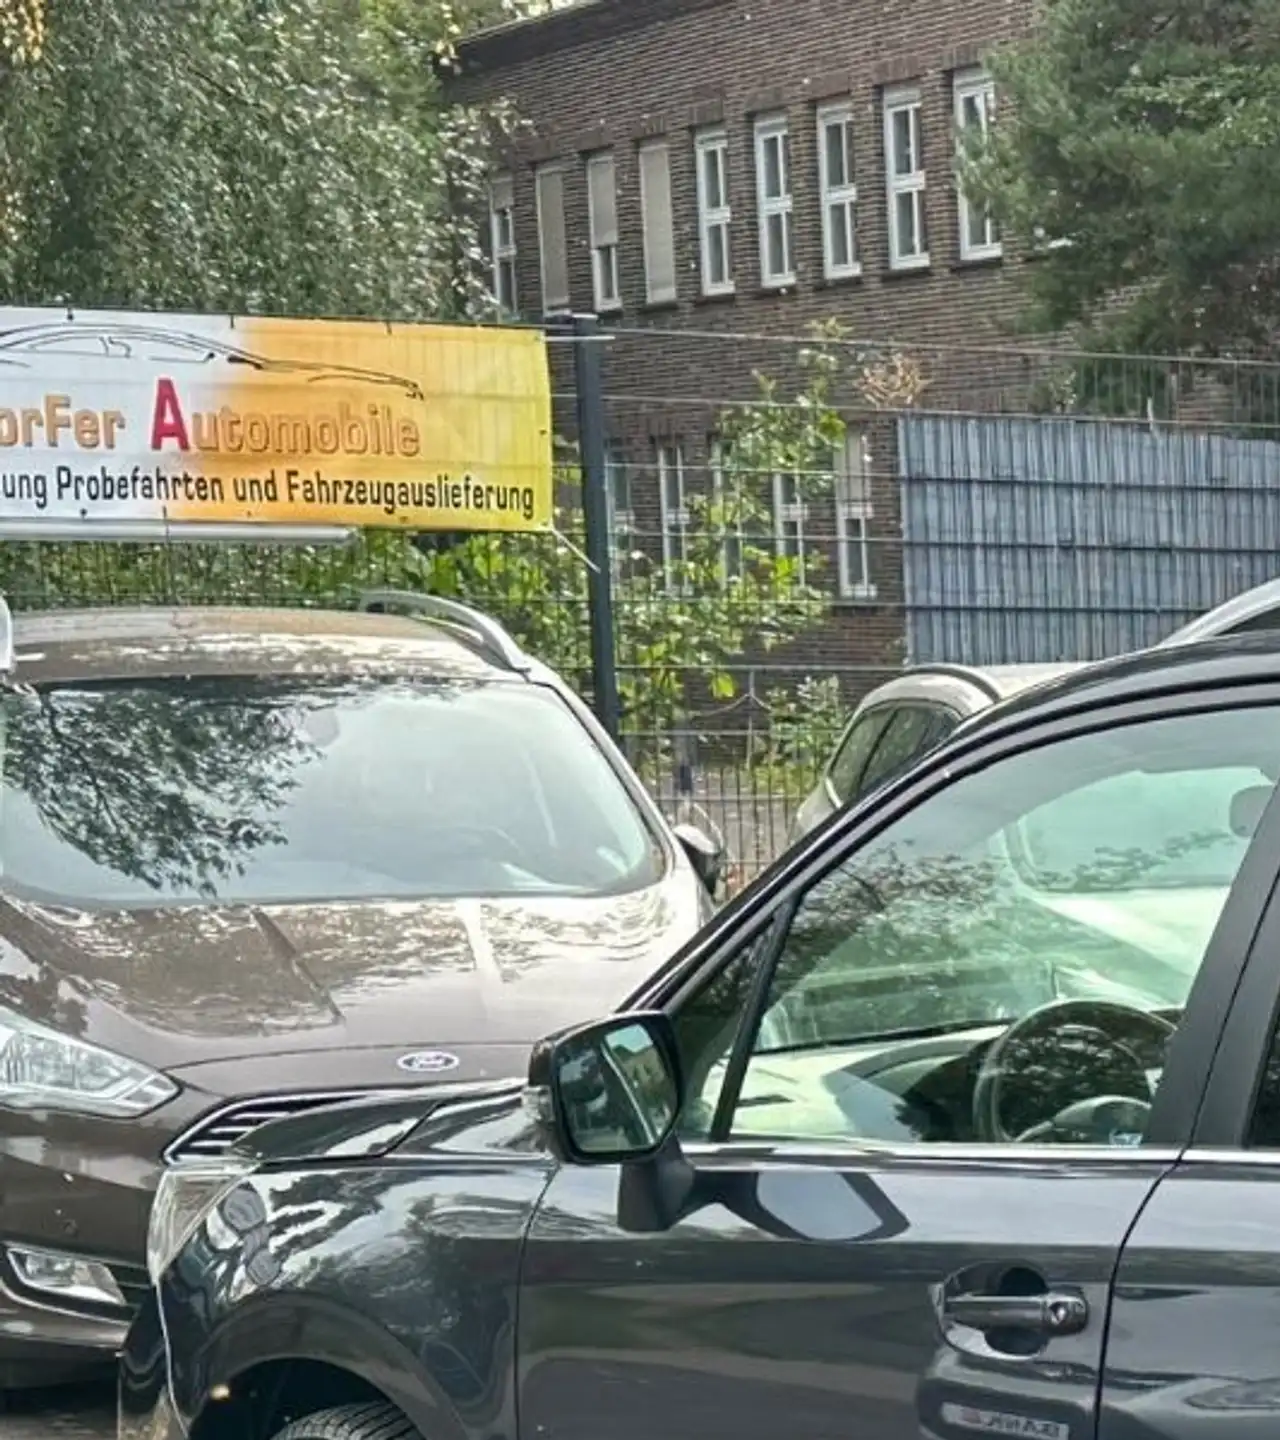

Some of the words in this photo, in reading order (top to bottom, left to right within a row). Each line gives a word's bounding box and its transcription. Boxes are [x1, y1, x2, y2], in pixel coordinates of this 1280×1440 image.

[150, 377, 422, 457] Automobile
[57, 465, 224, 503] Probefahrten
[234, 469, 278, 503] und
[286, 470, 535, 520] Fahrzeugauslieferung
